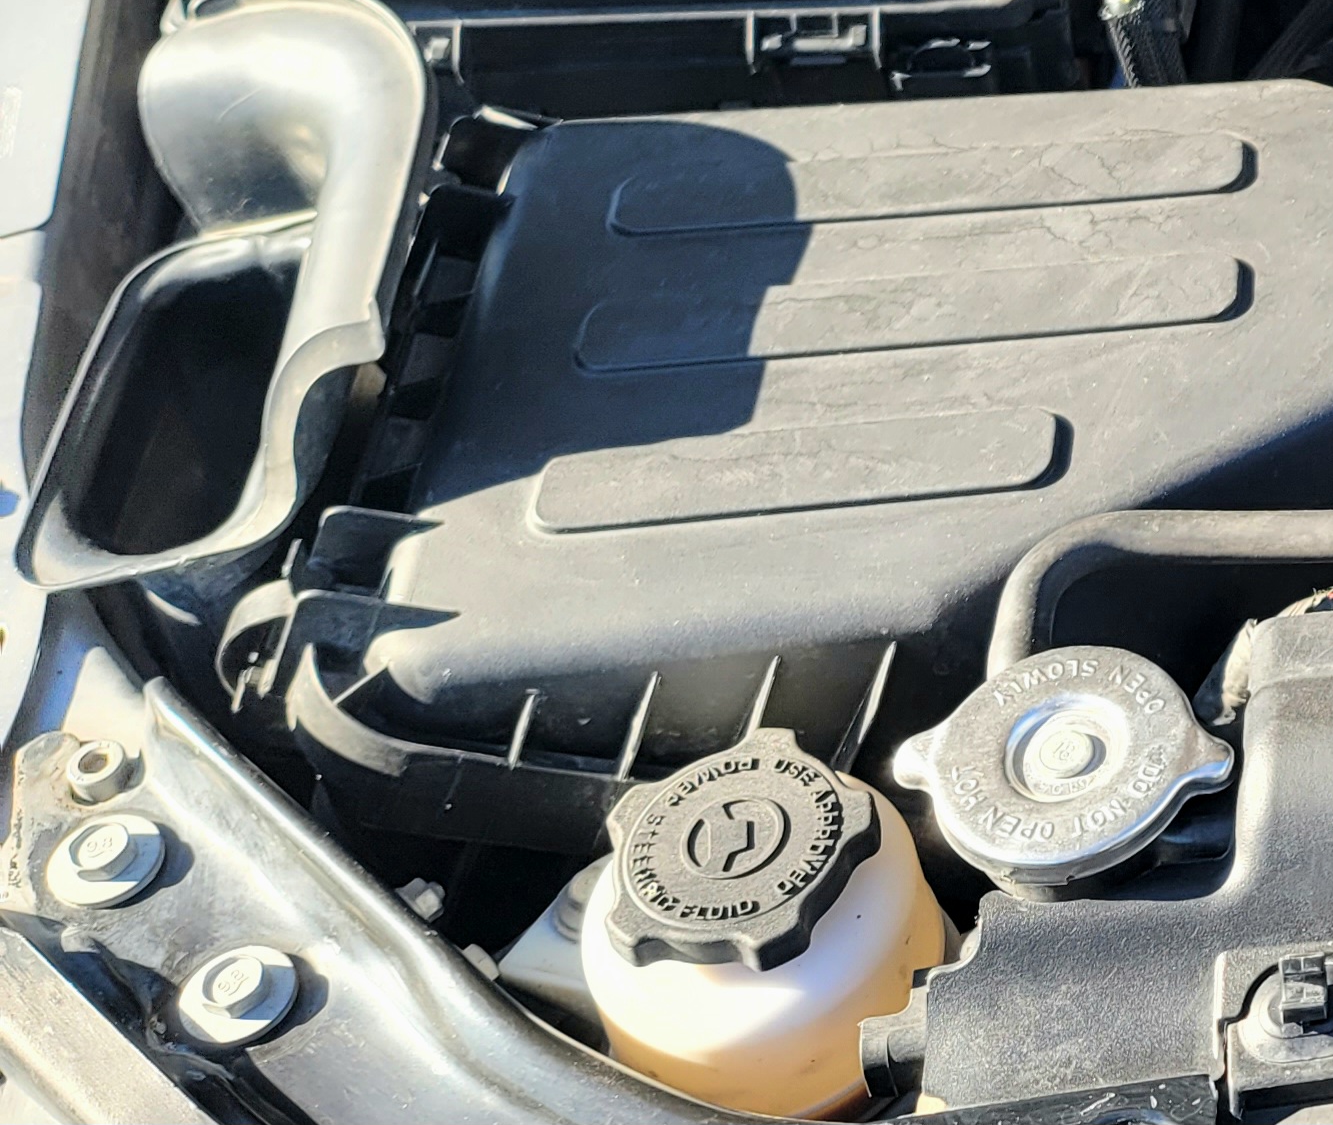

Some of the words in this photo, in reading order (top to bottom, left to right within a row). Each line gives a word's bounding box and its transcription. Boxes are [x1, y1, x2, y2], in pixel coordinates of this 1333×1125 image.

[992, 658, 1100, 708] SLOWLY
[1108, 664, 1167, 715] OPEN
[667, 757, 761, 806] POWER
[772, 758, 823, 787] USE
[776, 790, 844, 896] APPROVED
[978, 805, 1055, 841] OPEN
[1071, 799, 1128, 839] NOT
[631, 813, 681, 912] STEERING
[679, 900, 761, 920] FLUID
